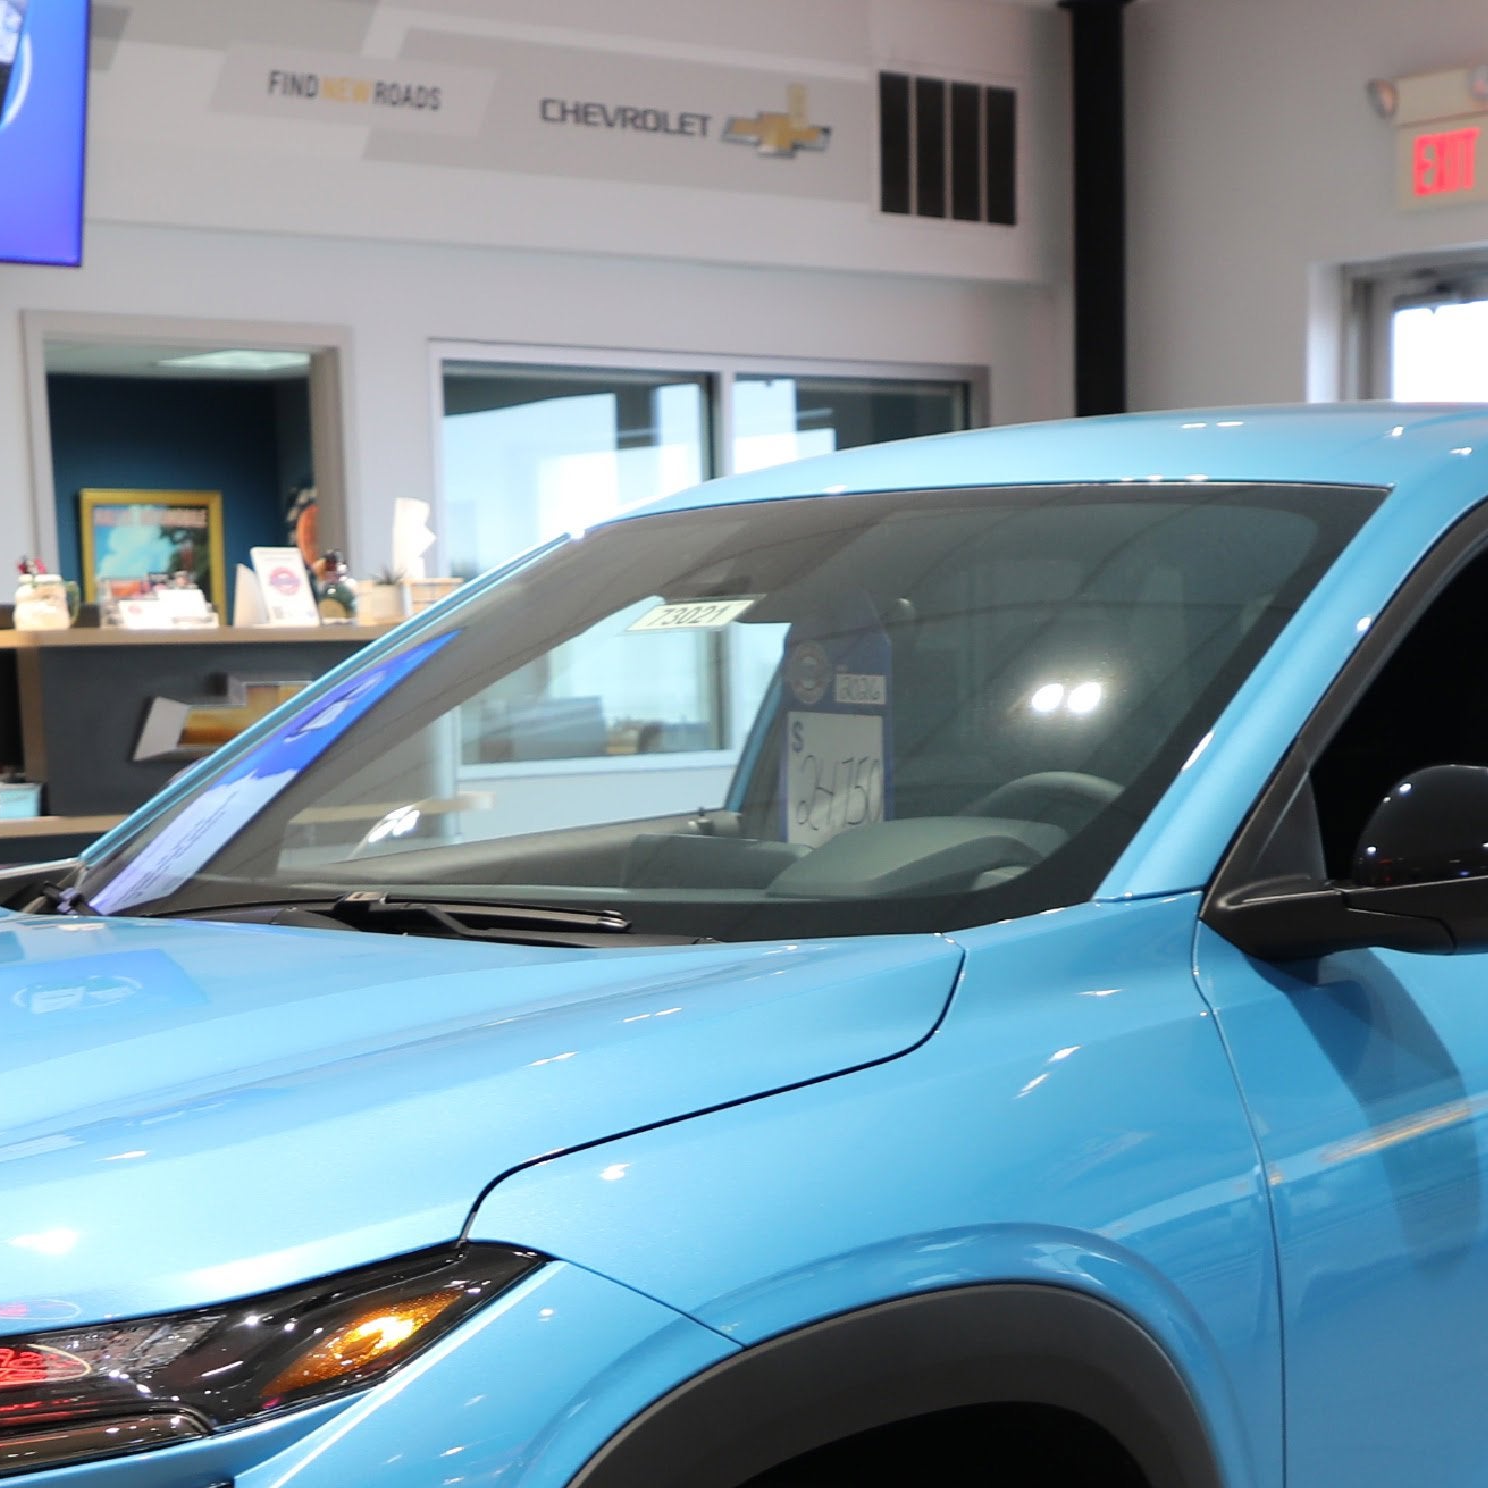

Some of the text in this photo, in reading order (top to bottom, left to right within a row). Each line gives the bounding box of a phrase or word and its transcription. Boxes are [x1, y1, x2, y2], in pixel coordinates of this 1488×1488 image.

[268, 69, 442, 111] FIND NEW ROADS
[539, 98, 712, 137] CHEVROLET
[1413, 127, 1480, 196] EXIT
[791, 720, 804, 754] $
